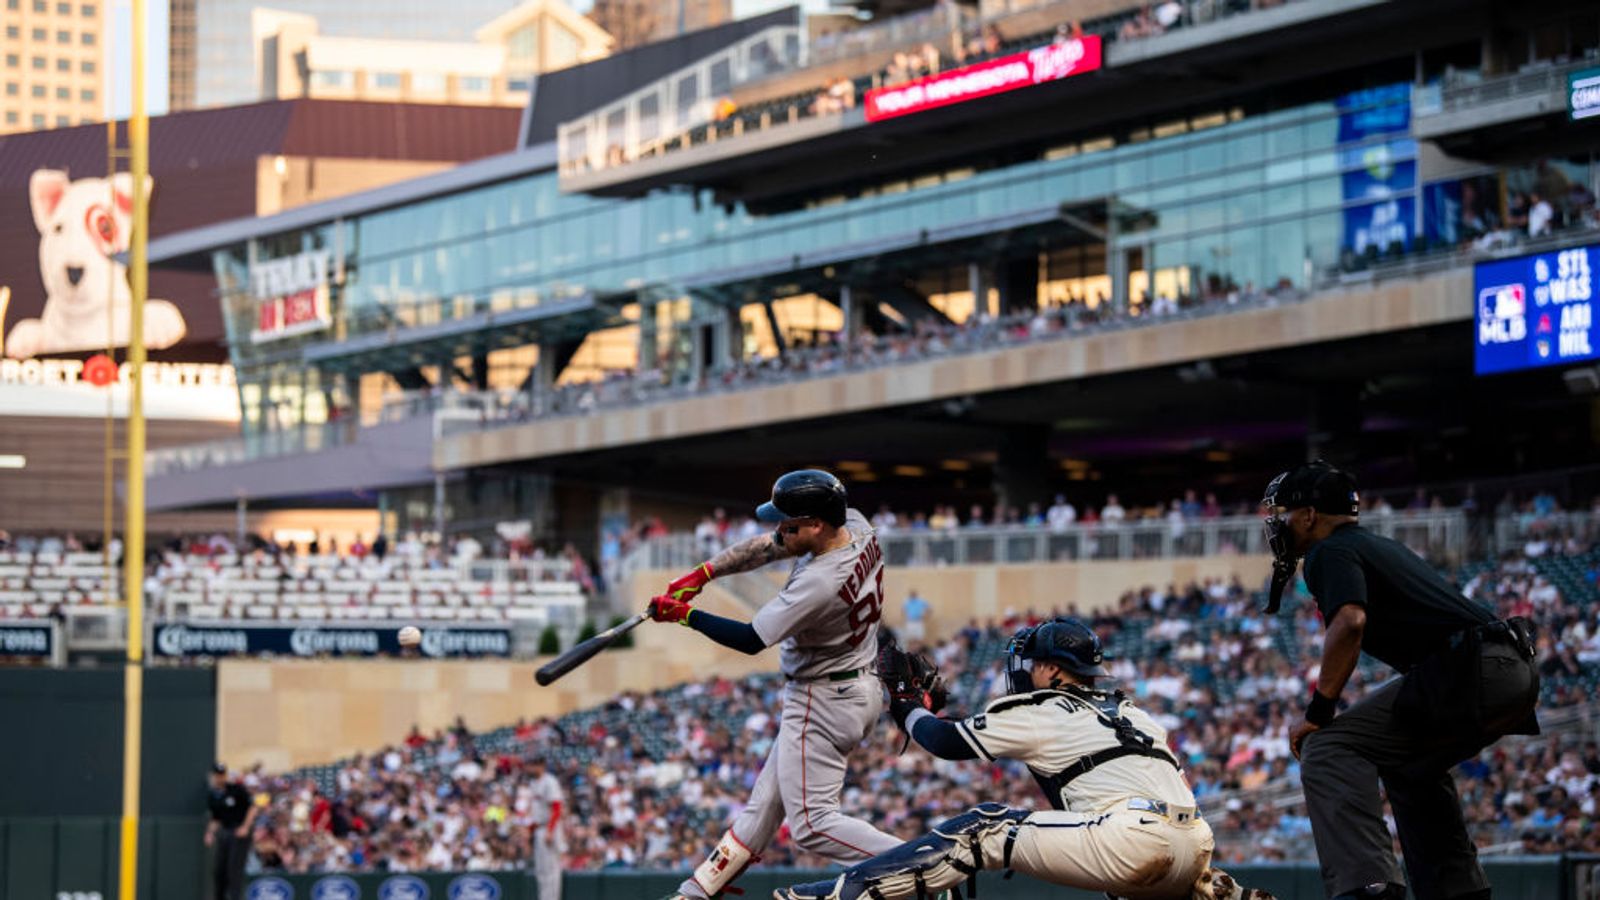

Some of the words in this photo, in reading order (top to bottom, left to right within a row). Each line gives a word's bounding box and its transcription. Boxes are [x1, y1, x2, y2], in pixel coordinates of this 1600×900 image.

[1549, 276, 1592, 304] WAS
[1479, 317, 1528, 345] MLB
[1559, 328, 1593, 357] MIL
[158, 625, 248, 655] Corona
[290, 626, 379, 656] Corona
[421, 627, 508, 657] Corona
